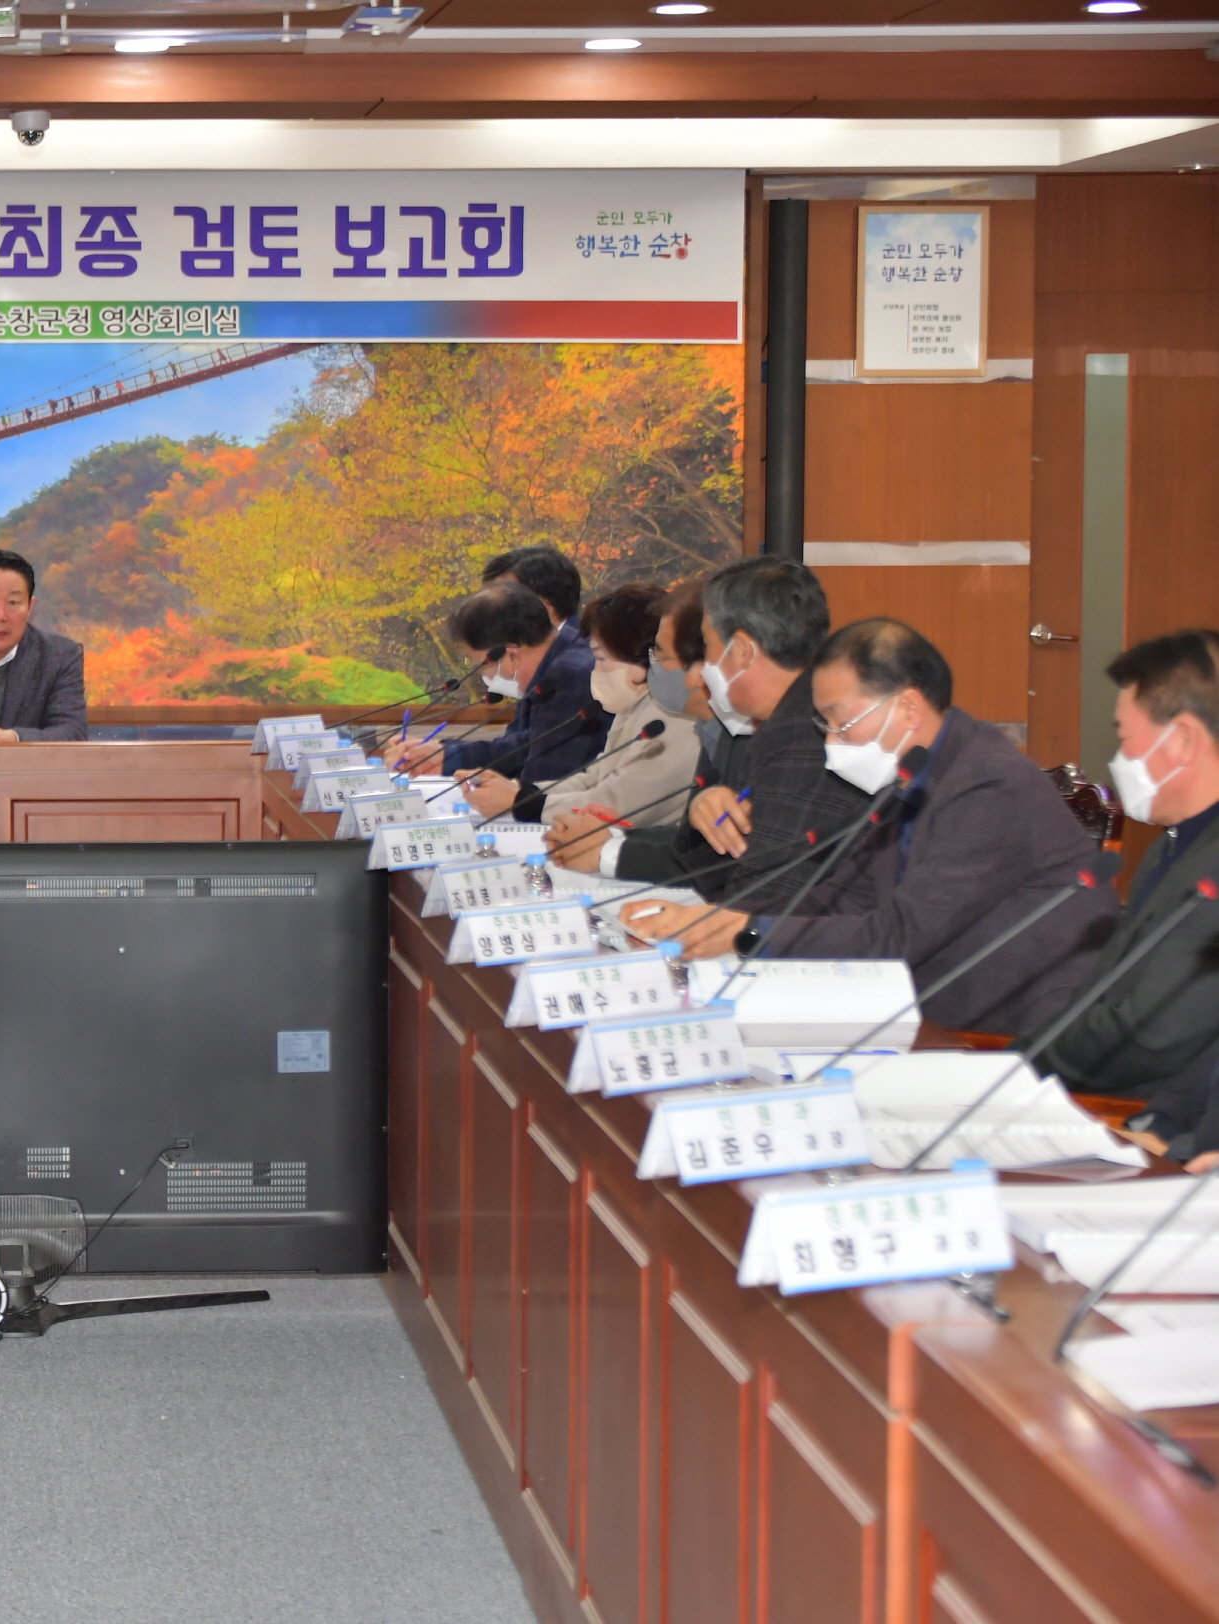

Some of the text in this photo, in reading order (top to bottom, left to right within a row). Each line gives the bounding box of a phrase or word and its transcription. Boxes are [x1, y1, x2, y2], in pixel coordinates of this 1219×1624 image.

[597, 211, 673, 226] 군민 모두가
[174, 204, 303, 278] 검토
[333, 203, 526, 278] 보고회
[575, 233, 692, 260] 행복한 순창
[882, 243, 964, 260] 군민 모두가
[882, 266, 964, 283] 행복한 순창
[100, 307, 240, 336] 영상회의실
